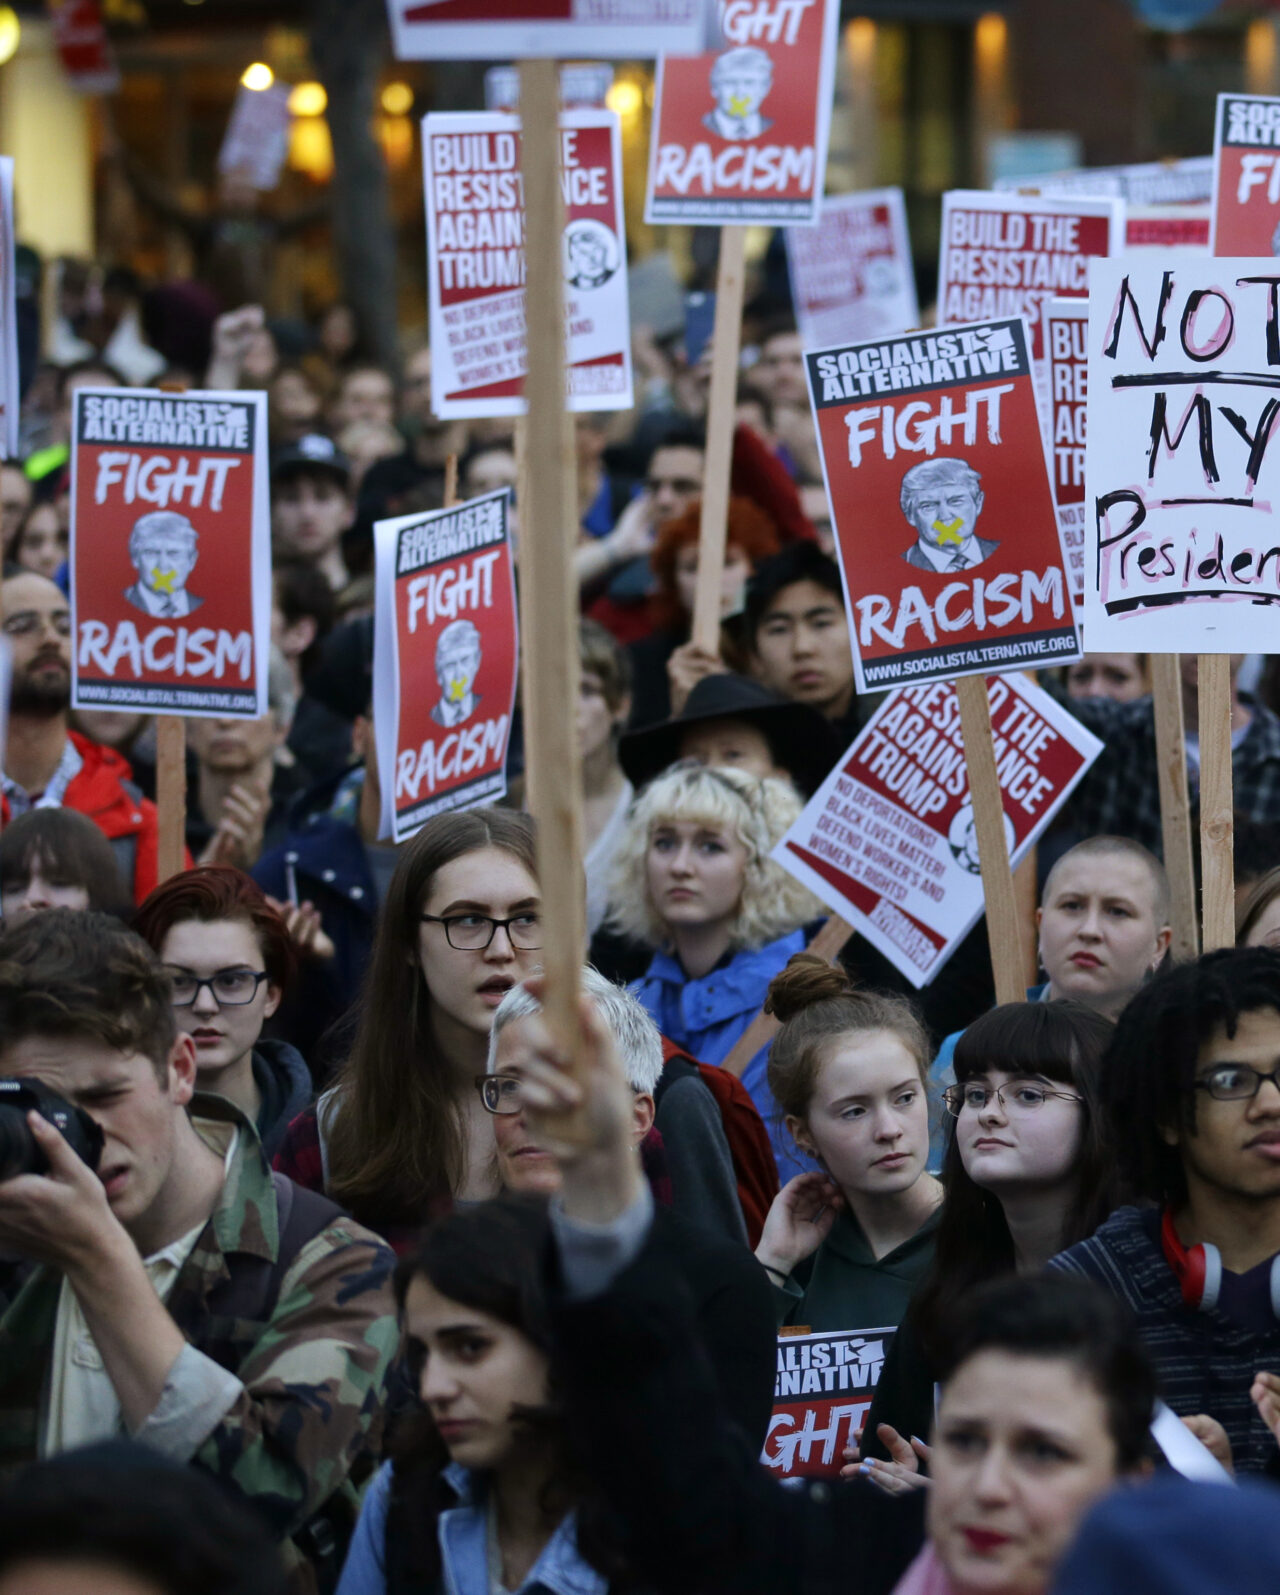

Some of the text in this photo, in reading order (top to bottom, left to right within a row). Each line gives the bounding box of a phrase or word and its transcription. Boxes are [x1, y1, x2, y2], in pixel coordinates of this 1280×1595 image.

[723, 0, 815, 46] GHT
[433, 134, 517, 172] BUILD
[654, 142, 814, 195] RACISM
[437, 211, 527, 251] AGAIN
[950, 211, 1081, 252] BUILD THE
[946, 248, 1089, 291] RESISTANC
[816, 330, 978, 379] SOCIALIST
[822, 346, 1020, 401] ALTERNATIVE
[84, 397, 218, 427] SOCIALIST
[84, 420, 248, 448] ALTERNATIVE
[844, 383, 1015, 467] FIGHT
[95, 451, 241, 512] FIGHT
[399, 520, 504, 574] ALTERNATIVE
[401, 505, 484, 552] SOCIALIST
[407, 550, 501, 633] FIGHT
[855, 566, 1066, 649] RACISM
[79, 619, 252, 681] RACISM
[865, 635, 1076, 683] WWW.SOCIALISTALTERNATIVE.ORG
[396, 713, 509, 799] RACISM
[998, 698, 1058, 764] THE
[858, 728, 949, 818] TRUMP
[825, 794, 947, 880] BLACK LIVES MATTER!
[834, 775, 938, 850] NO DEPORTATIONS!
[807, 833, 908, 903] WOMEN'S RIGHTS!
[815, 812, 946, 904] DEFEND WORKER'S AND
[777, 1340, 850, 1372] ALIST
[759, 1401, 873, 1473] GHT
